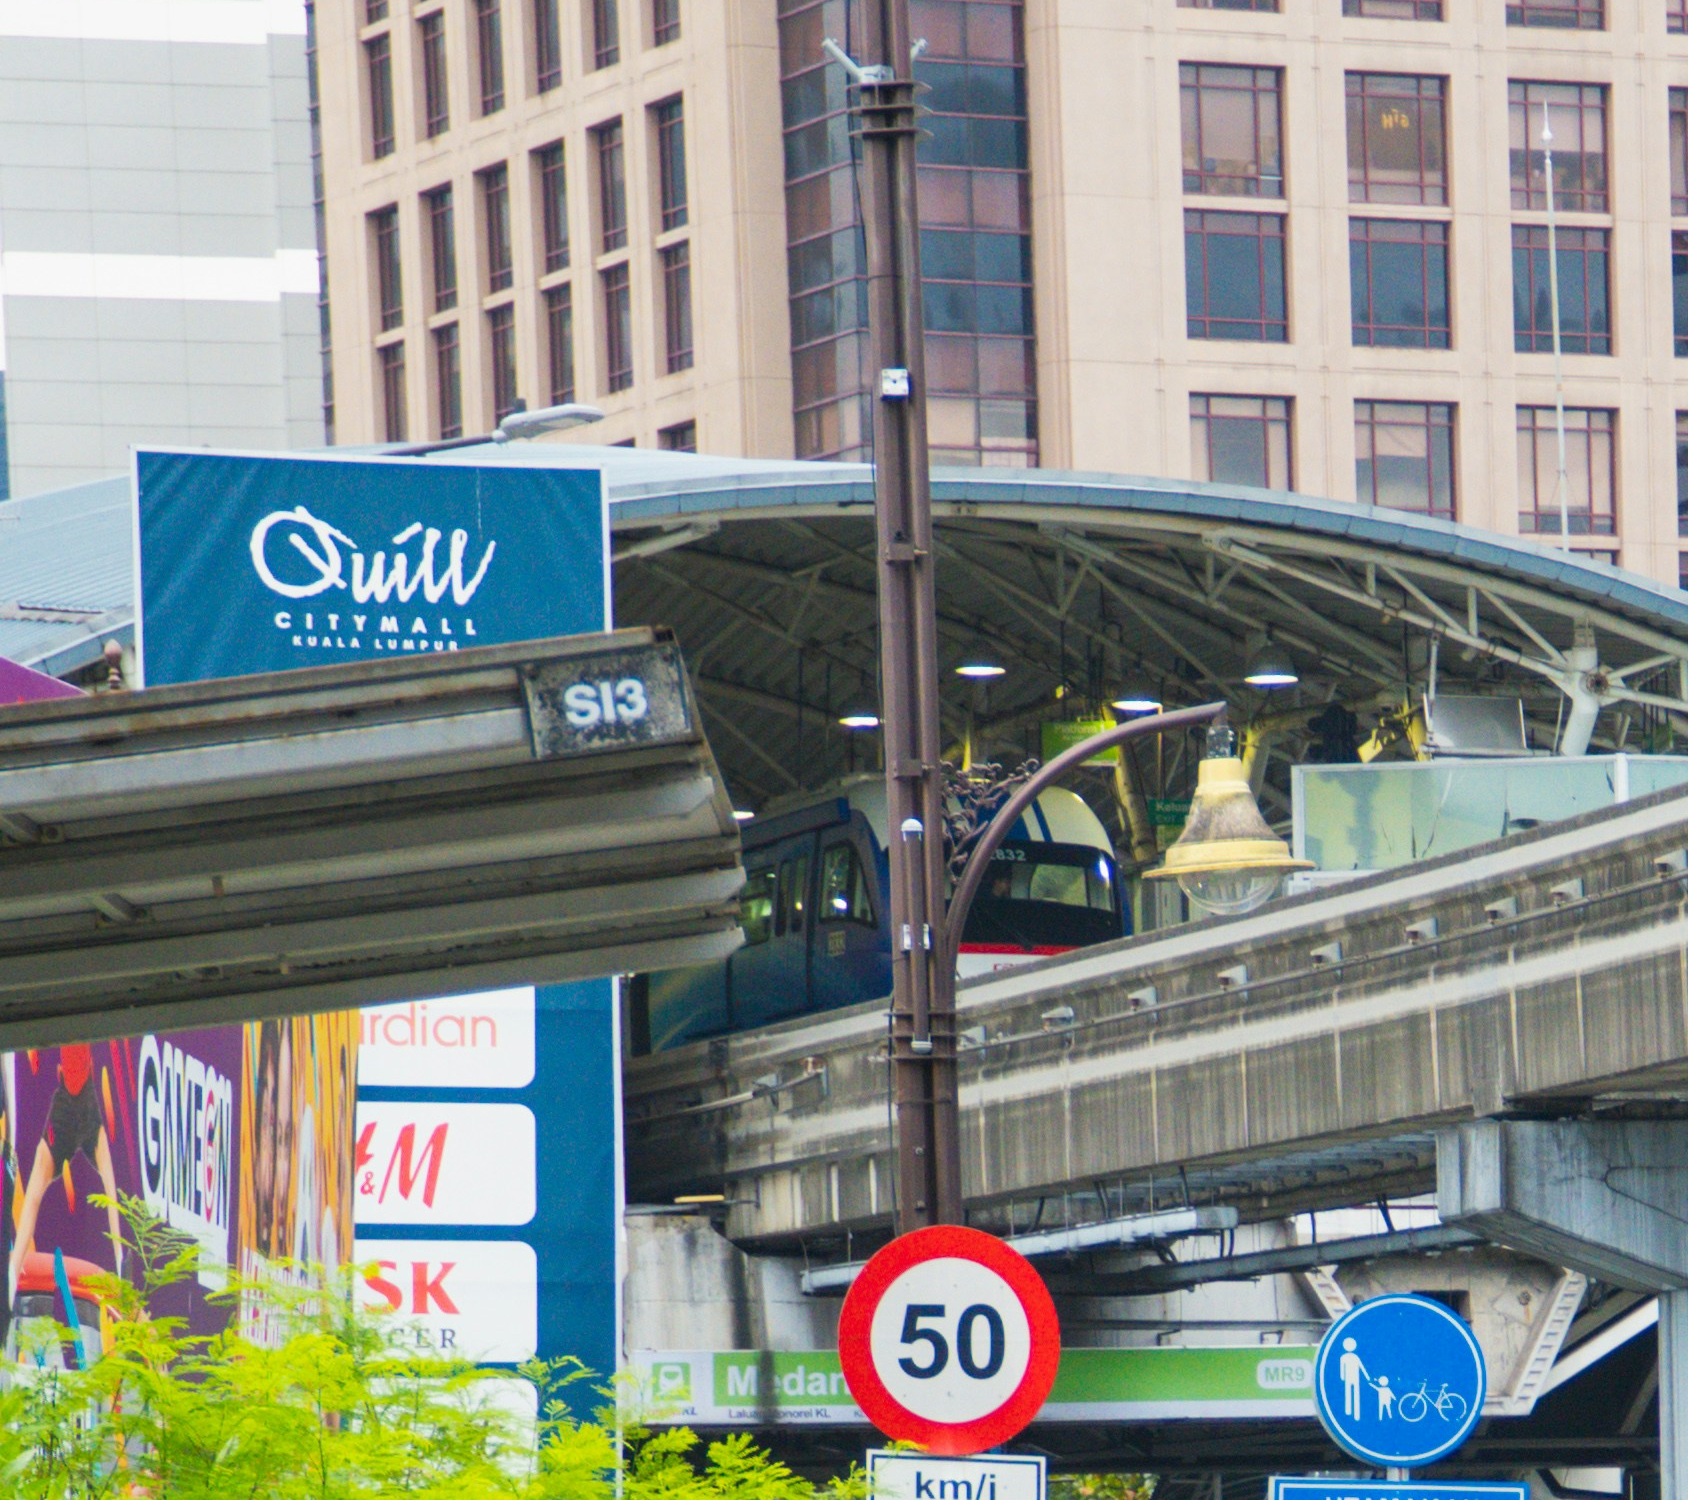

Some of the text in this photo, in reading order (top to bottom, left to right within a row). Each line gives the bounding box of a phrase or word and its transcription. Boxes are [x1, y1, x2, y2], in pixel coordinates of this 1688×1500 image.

[250, 505, 496, 606] Quill
[273, 611, 477, 636] CITYMALL
[292, 635, 460, 651] KUALA LUMPUR
[990, 848, 1027, 862] 832
[359, 1002, 498, 1048] rdian
[897, 1303, 1006, 1381] 50
[1264, 1366, 1306, 1383] MR9
